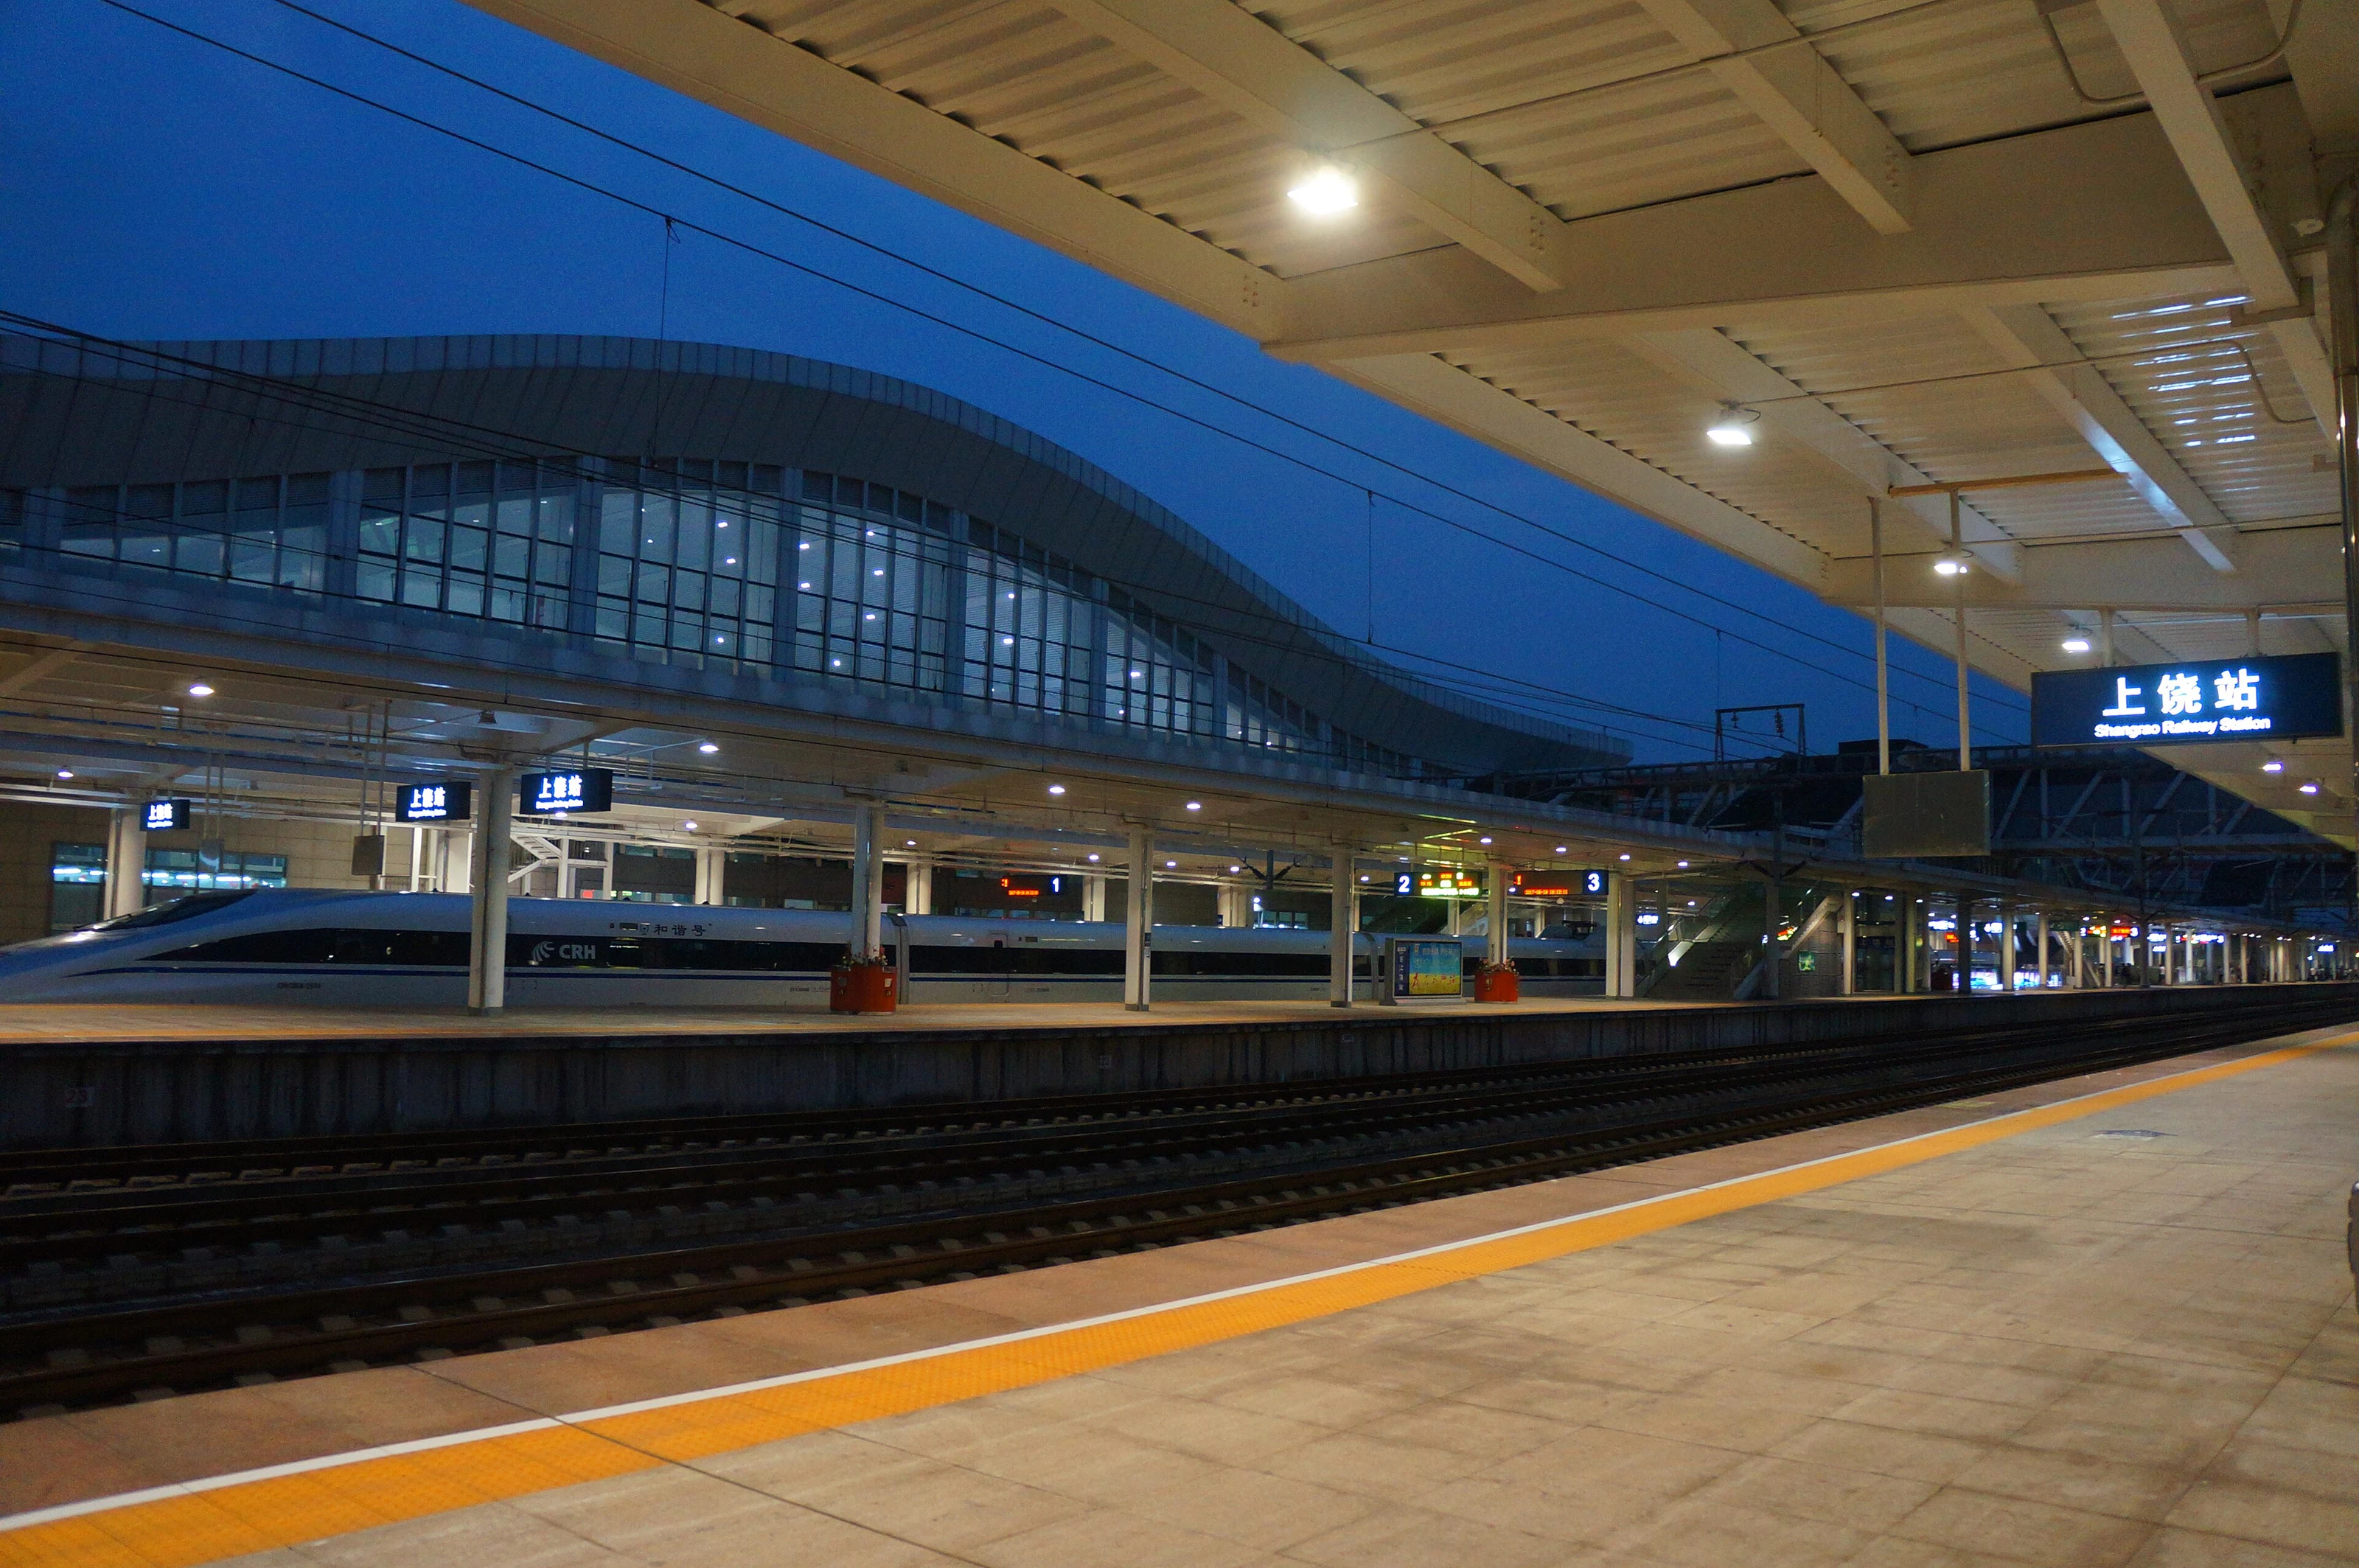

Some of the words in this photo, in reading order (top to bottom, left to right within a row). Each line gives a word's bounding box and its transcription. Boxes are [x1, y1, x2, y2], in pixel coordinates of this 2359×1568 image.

[2102, 669, 2259, 717] 上饶站
[2094, 723, 2161, 738] Shangrao
[2161, 719, 2218, 735] Railway
[2219, 716, 2271, 732] Station
[1053, 877, 1059, 893] 1
[1398, 875, 1410, 892] 2
[1588, 873, 1600, 891] 3
[654, 924, 705, 936] 和谐号
[559, 945, 596, 959] CRH
